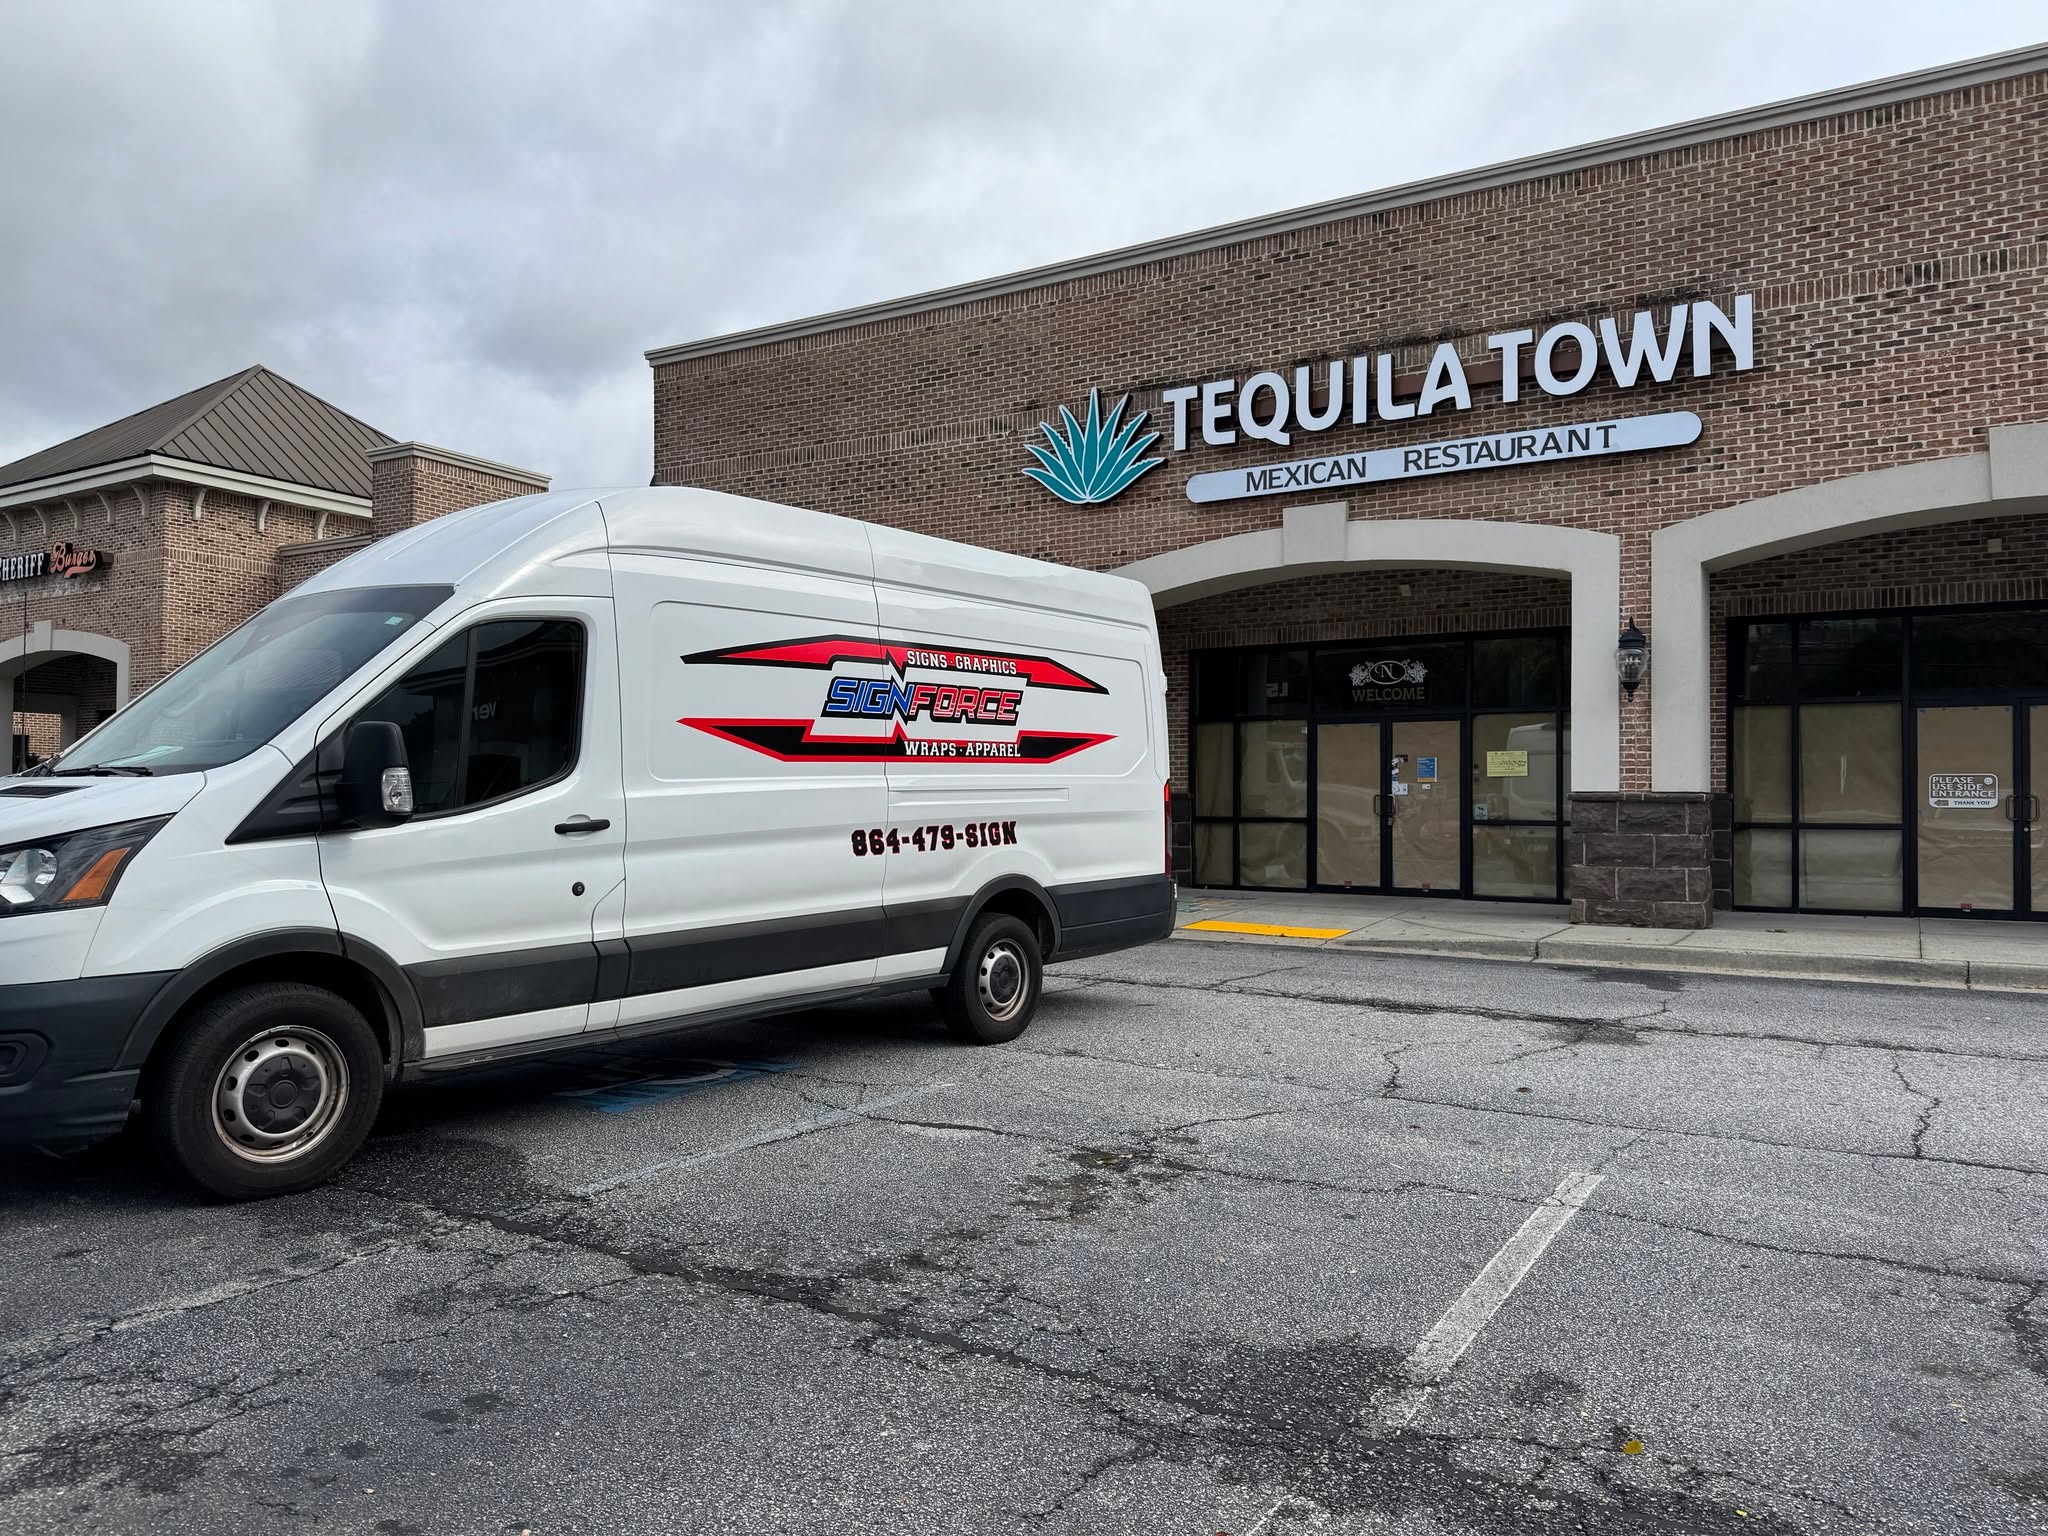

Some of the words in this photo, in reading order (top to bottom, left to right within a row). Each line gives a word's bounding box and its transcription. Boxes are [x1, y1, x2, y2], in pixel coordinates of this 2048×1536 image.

[1162, 342, 1471, 452] TEQUILA
[1487, 294, 1755, 404] TOWN
[1245, 456, 1368, 494] MEXICAN
[1403, 423, 1619, 472] RESTAURANT
[50, 541, 97, 578] Burger
[907, 650, 947, 669] SIGNS
[955, 656, 1017, 674] GRAPHICS
[1374, 663, 1397, 681] N
[825, 678, 1023, 722] SIGNFORCE
[1351, 687, 1425, 703] WELCOME
[904, 741, 957, 757] WRAPS
[965, 741, 1021, 758] APPAREL
[850, 820, 1018, 857] 864-479-SIGN
